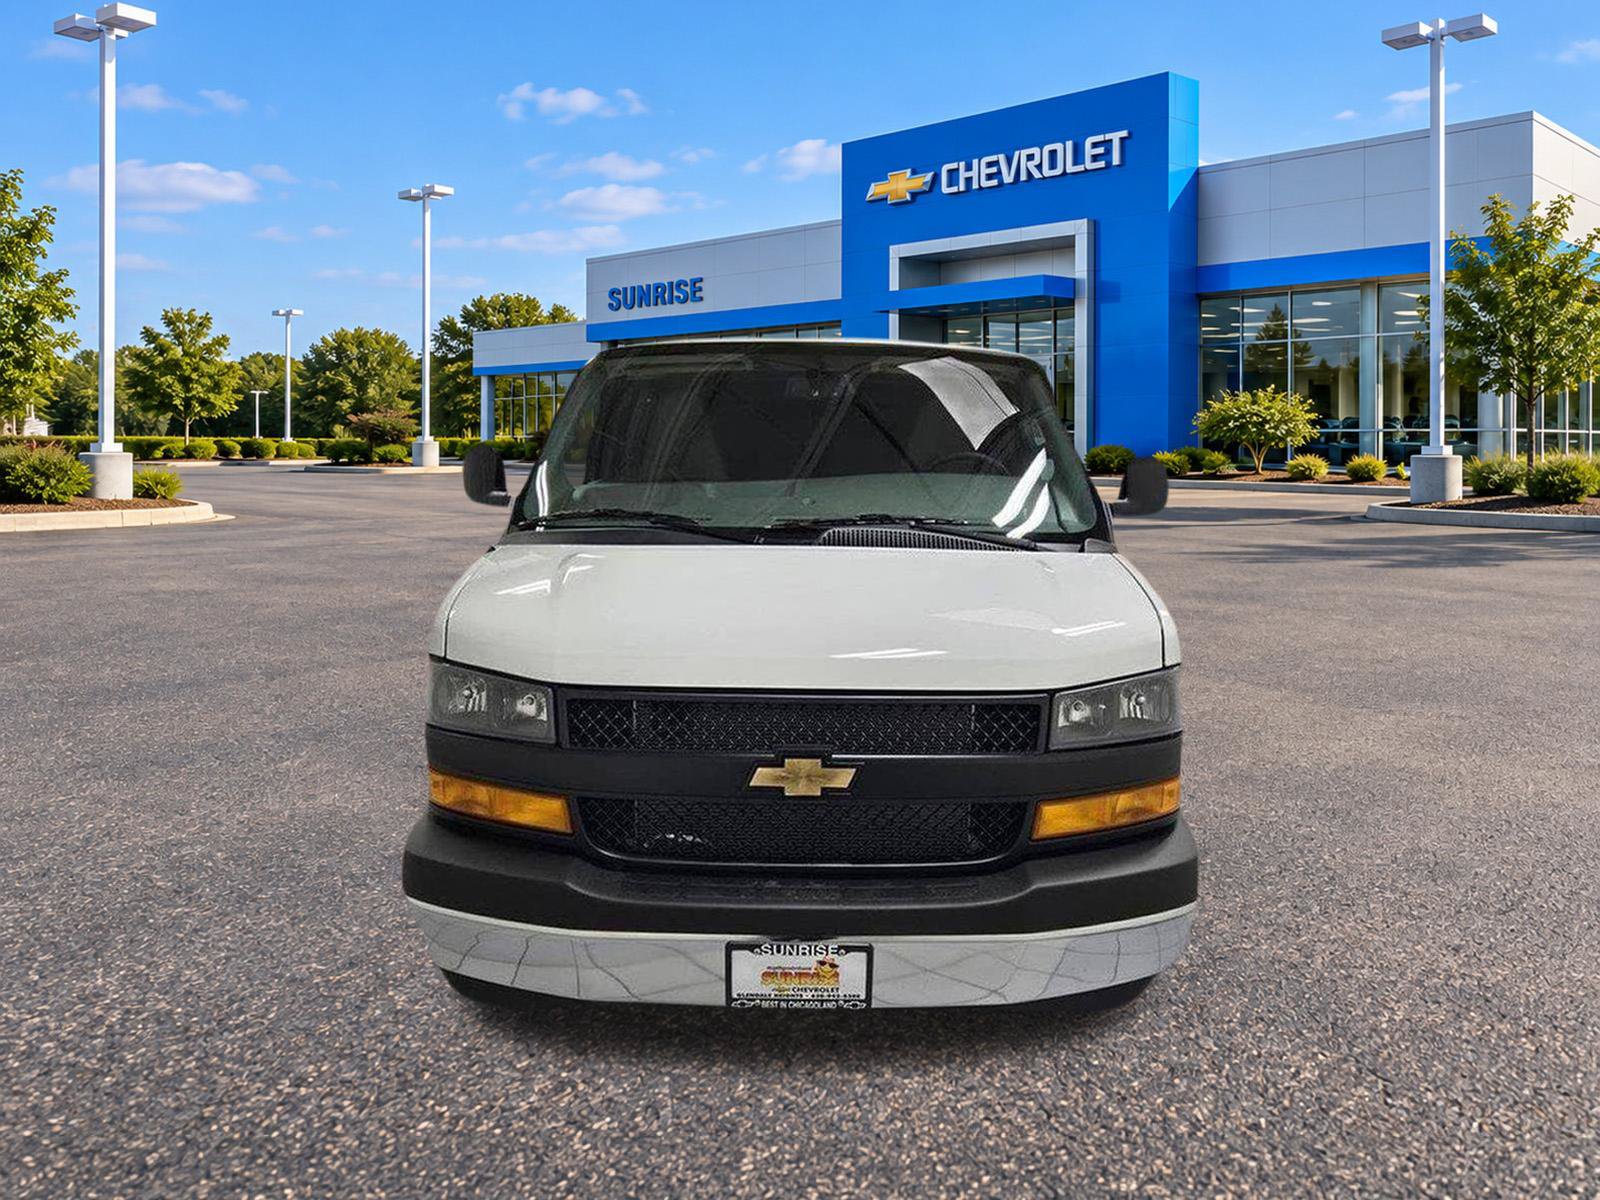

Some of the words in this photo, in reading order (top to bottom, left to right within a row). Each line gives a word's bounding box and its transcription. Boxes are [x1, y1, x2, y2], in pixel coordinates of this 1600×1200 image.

[941, 129, 1130, 195] CHEVROLET
[607, 276, 704, 312] SUNRISE
[761, 943, 838, 956] SUNRISE
